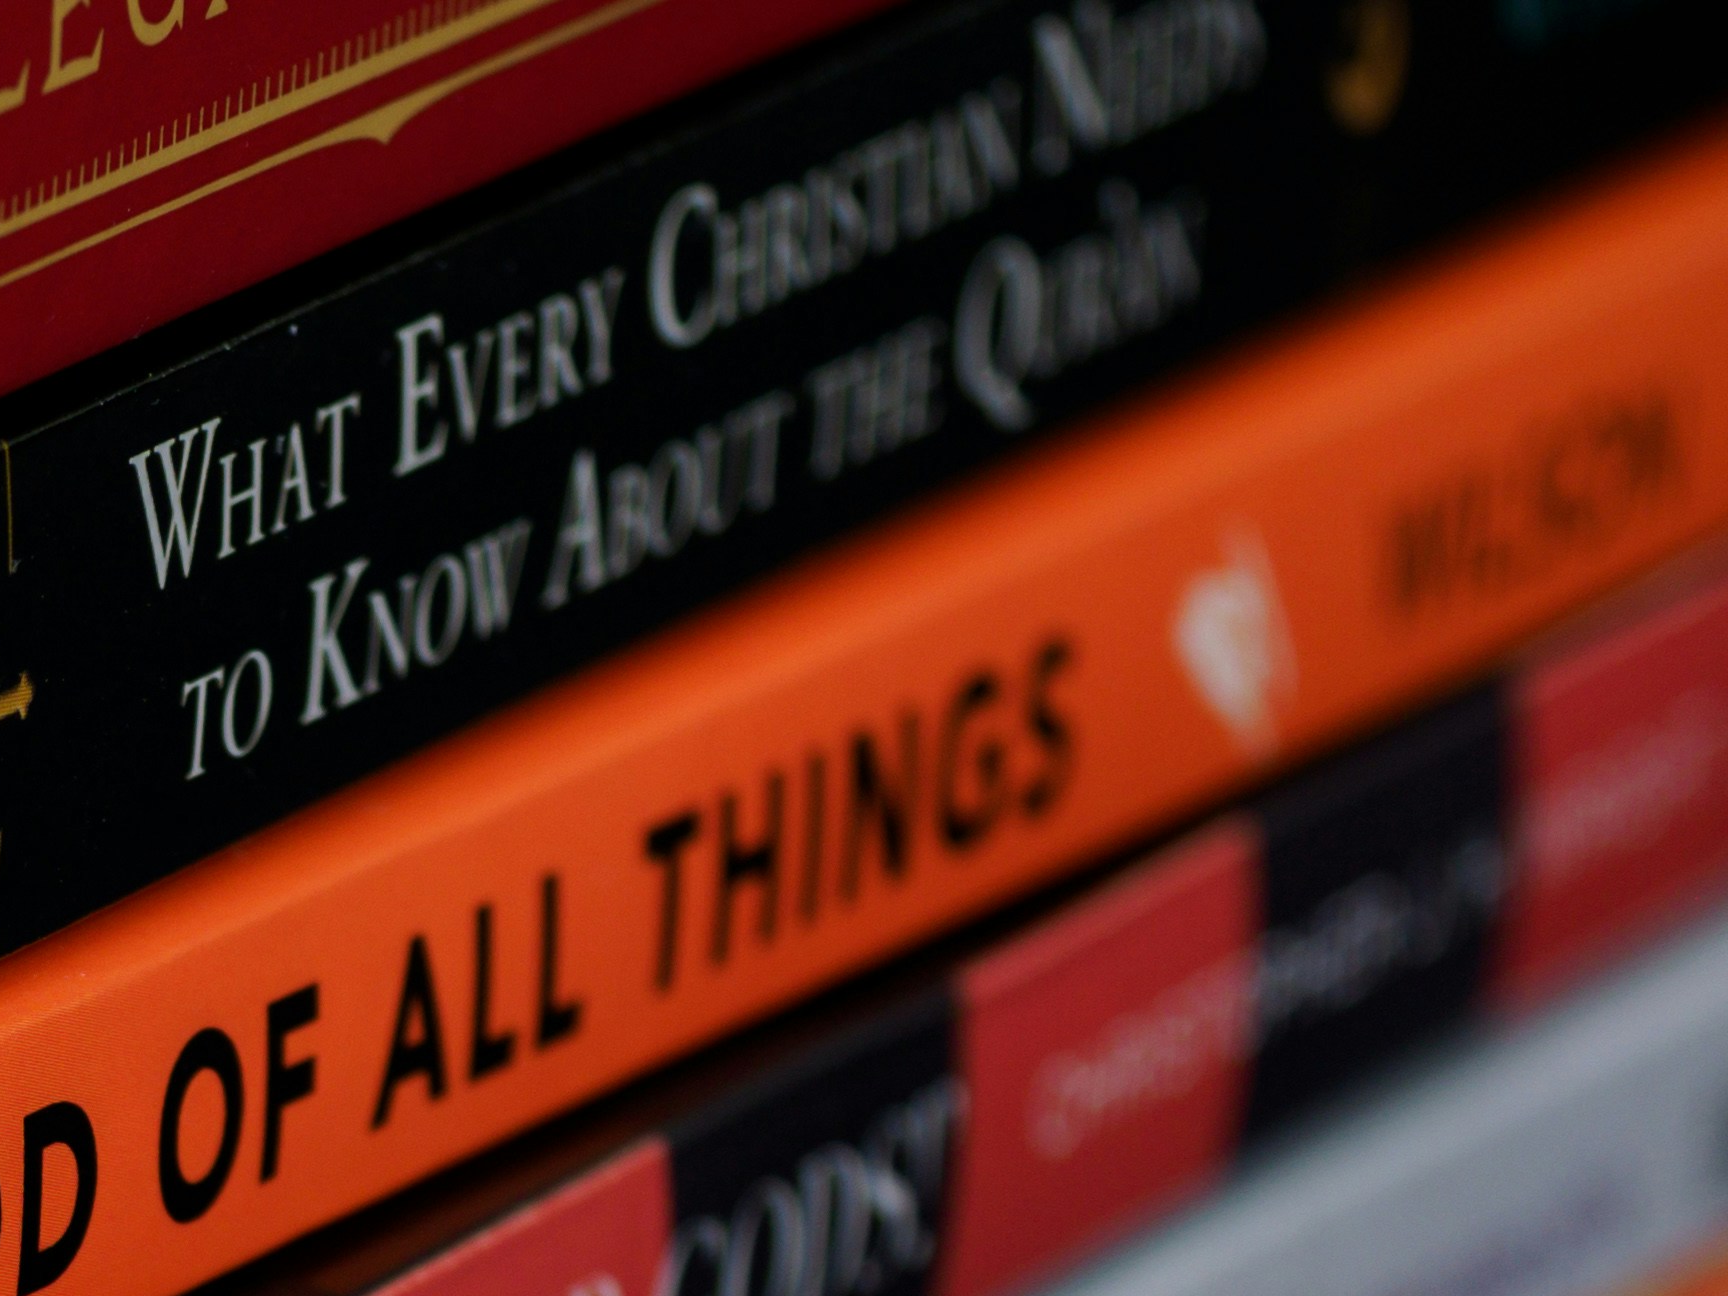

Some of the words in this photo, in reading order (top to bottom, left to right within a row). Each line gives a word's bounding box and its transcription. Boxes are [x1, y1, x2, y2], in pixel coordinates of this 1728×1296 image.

[157, 981, 321, 1226] OF
[369, 870, 588, 1135] ALL
[642, 635, 1079, 995] THINGS
